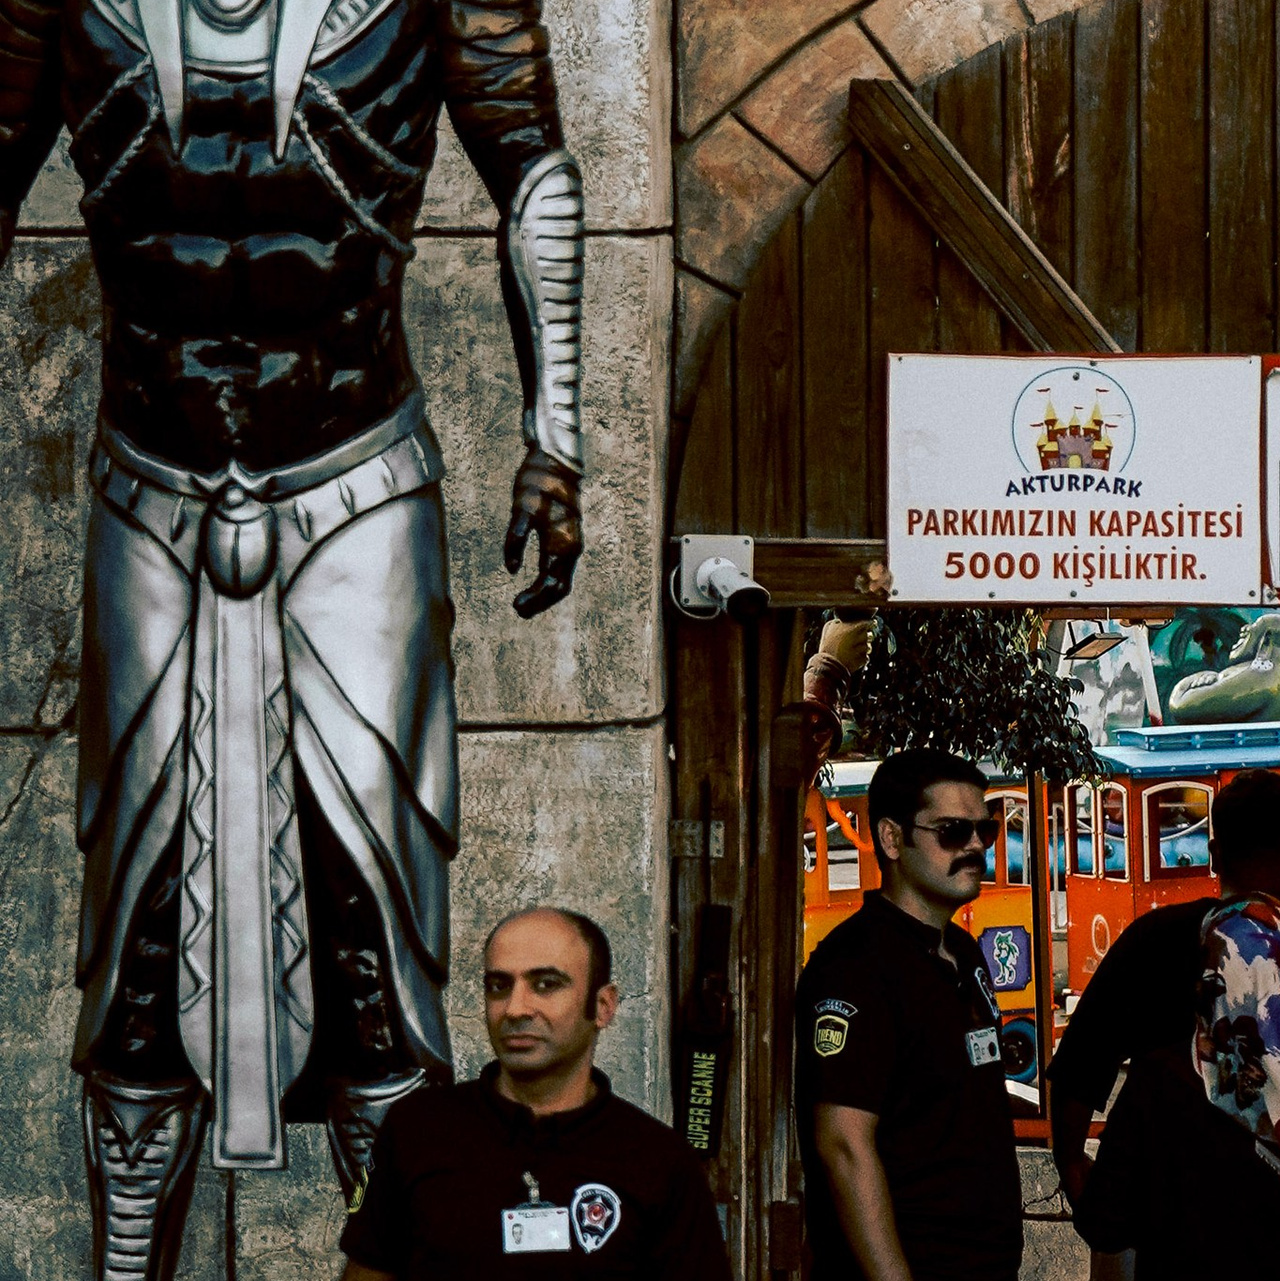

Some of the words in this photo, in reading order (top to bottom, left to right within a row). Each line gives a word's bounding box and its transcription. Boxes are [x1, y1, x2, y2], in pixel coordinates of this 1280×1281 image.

[1005, 473, 1143, 498] AKTURPARK
[907, 508, 1078, 538] PARKIMIZIN
[1089, 503, 1244, 539] KAPASİTESİ
[944, 551, 1042, 580] 5000
[1052, 545, 1207, 588] KİŞİLİKTİR.
